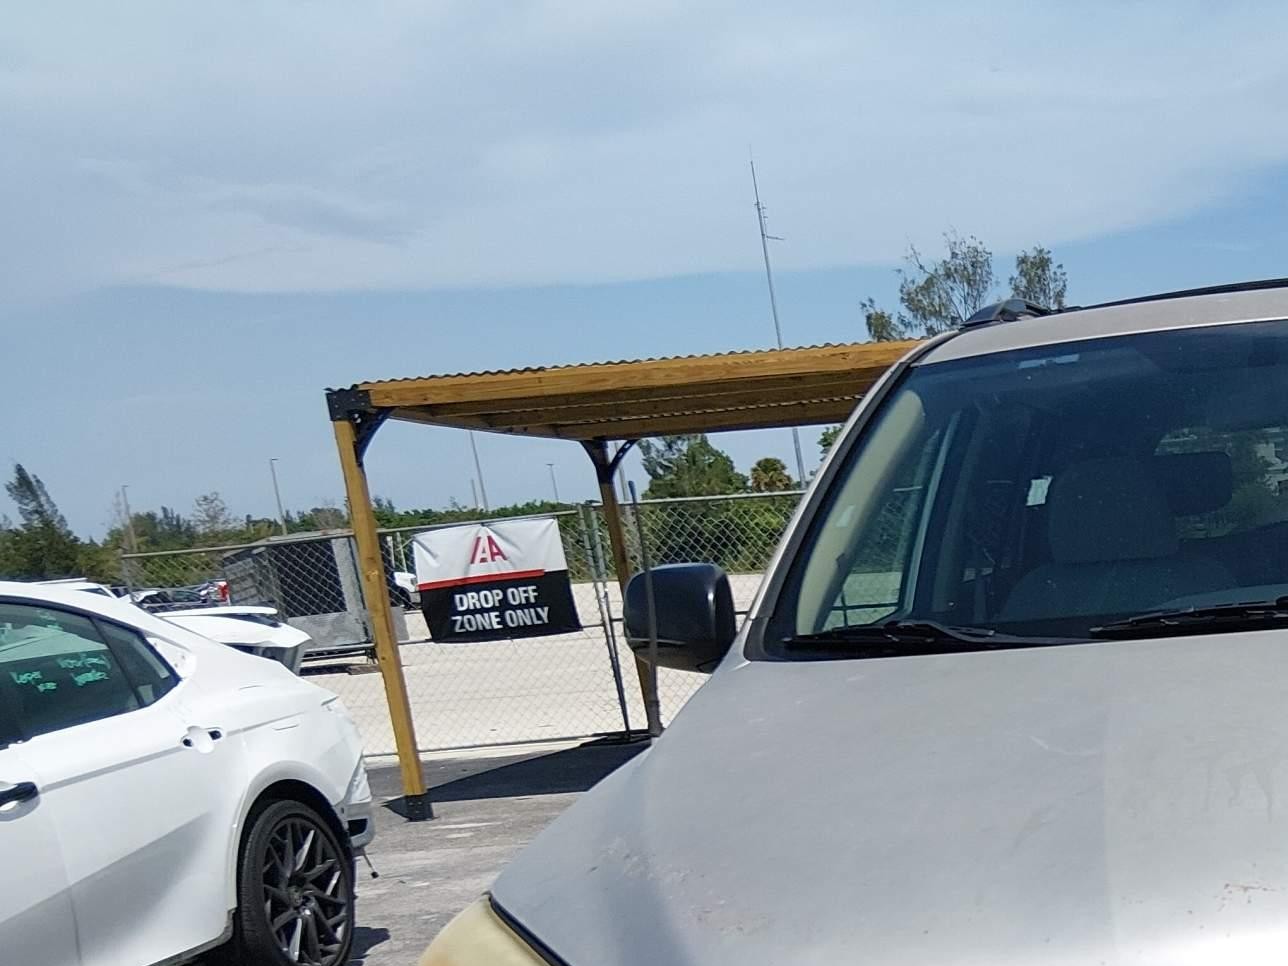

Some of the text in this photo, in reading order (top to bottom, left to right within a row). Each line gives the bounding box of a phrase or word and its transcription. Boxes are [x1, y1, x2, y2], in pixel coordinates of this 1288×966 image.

[454, 586, 539, 611] DROP OFF
[451, 606, 550, 632] ZONE ONLY
